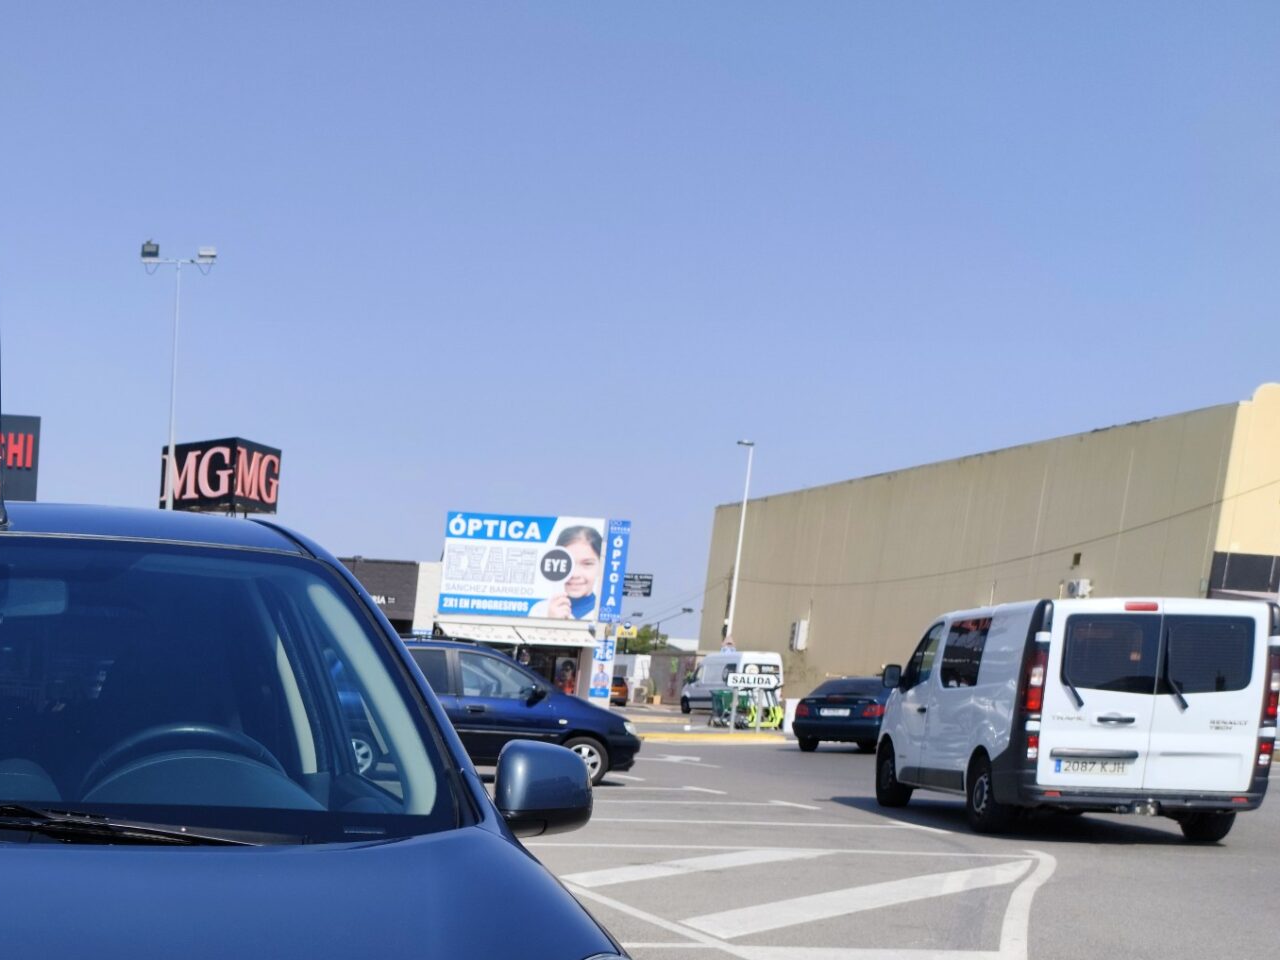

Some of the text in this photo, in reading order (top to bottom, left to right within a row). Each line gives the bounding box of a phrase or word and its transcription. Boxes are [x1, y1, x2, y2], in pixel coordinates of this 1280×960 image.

[160, 446, 233, 501] MG
[234, 446, 280, 504] MG
[448, 513, 543, 541] ÓPTICA
[543, 558, 568, 573] EYE
[606, 535, 624, 607] ÓPTICA
[731, 675, 772, 685] SALIDA
[1063, 760, 1097, 772] 2087
